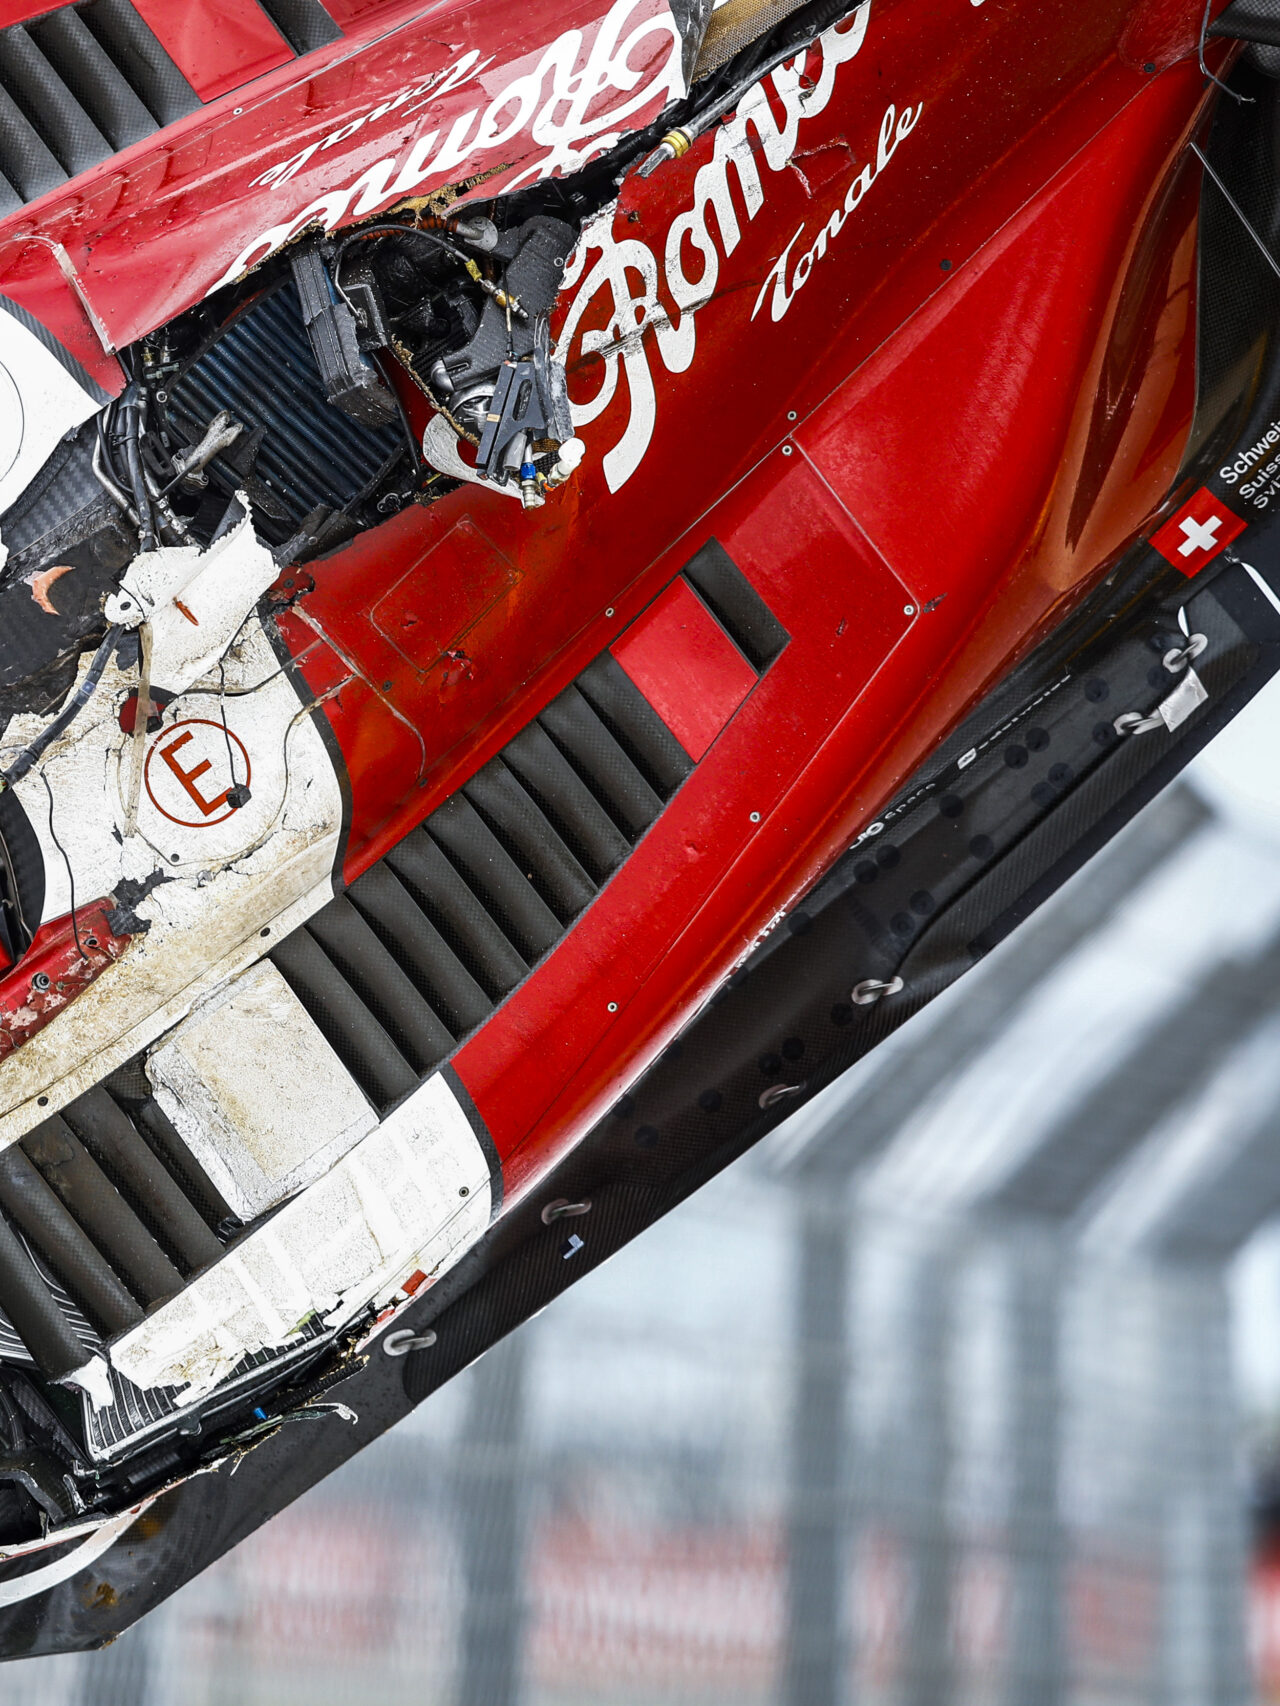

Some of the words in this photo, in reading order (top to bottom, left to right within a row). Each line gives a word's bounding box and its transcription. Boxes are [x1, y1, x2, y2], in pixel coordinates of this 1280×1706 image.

[750, 102, 923, 322] Tonale
[1219, 420, 1280, 485] Schwei
[159, 729, 232, 817] E
